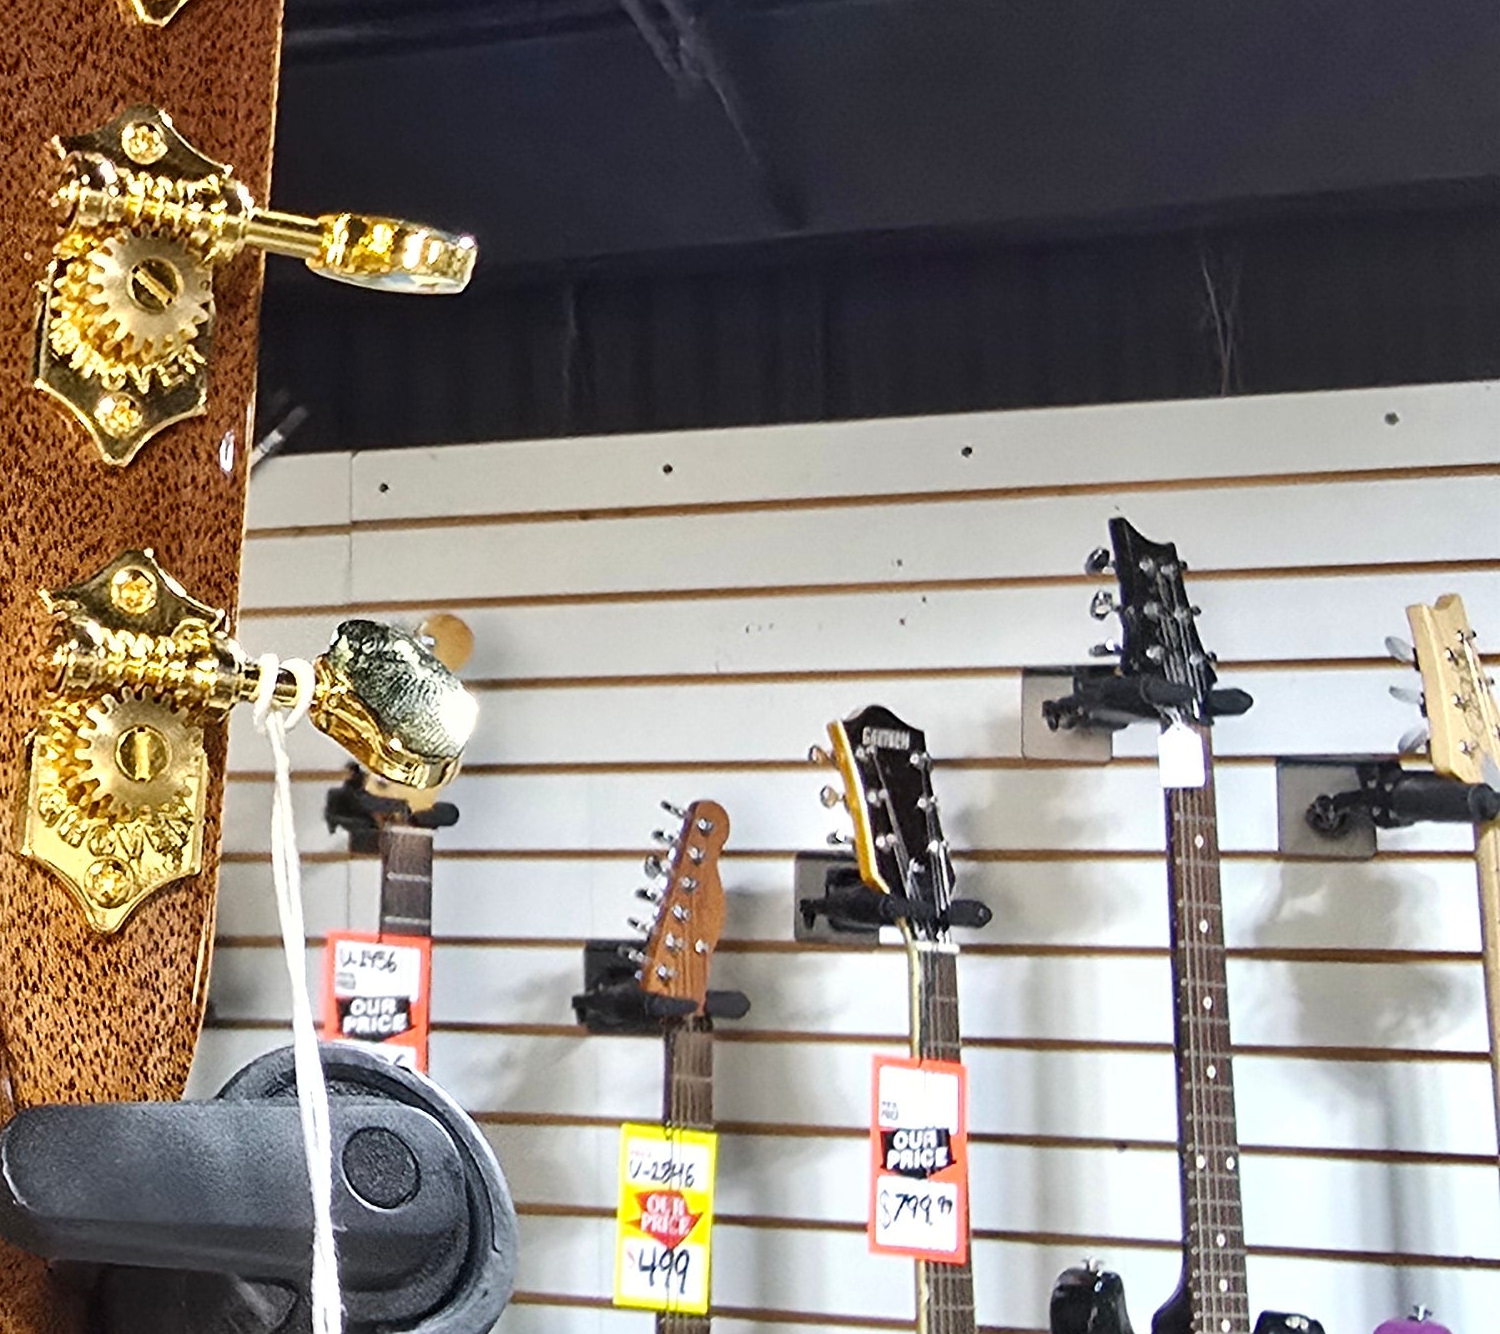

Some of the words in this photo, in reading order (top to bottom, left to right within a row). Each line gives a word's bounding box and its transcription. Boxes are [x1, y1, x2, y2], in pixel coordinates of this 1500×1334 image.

[350, 998, 397, 1017] OUR
[342, 1013, 407, 1035] PRICE
[893, 1128, 937, 1151] OUR
[887, 1147, 949, 1171] PRICE
[646, 1193, 685, 1216] OUR
[640, 1210, 692, 1236] PRICE
